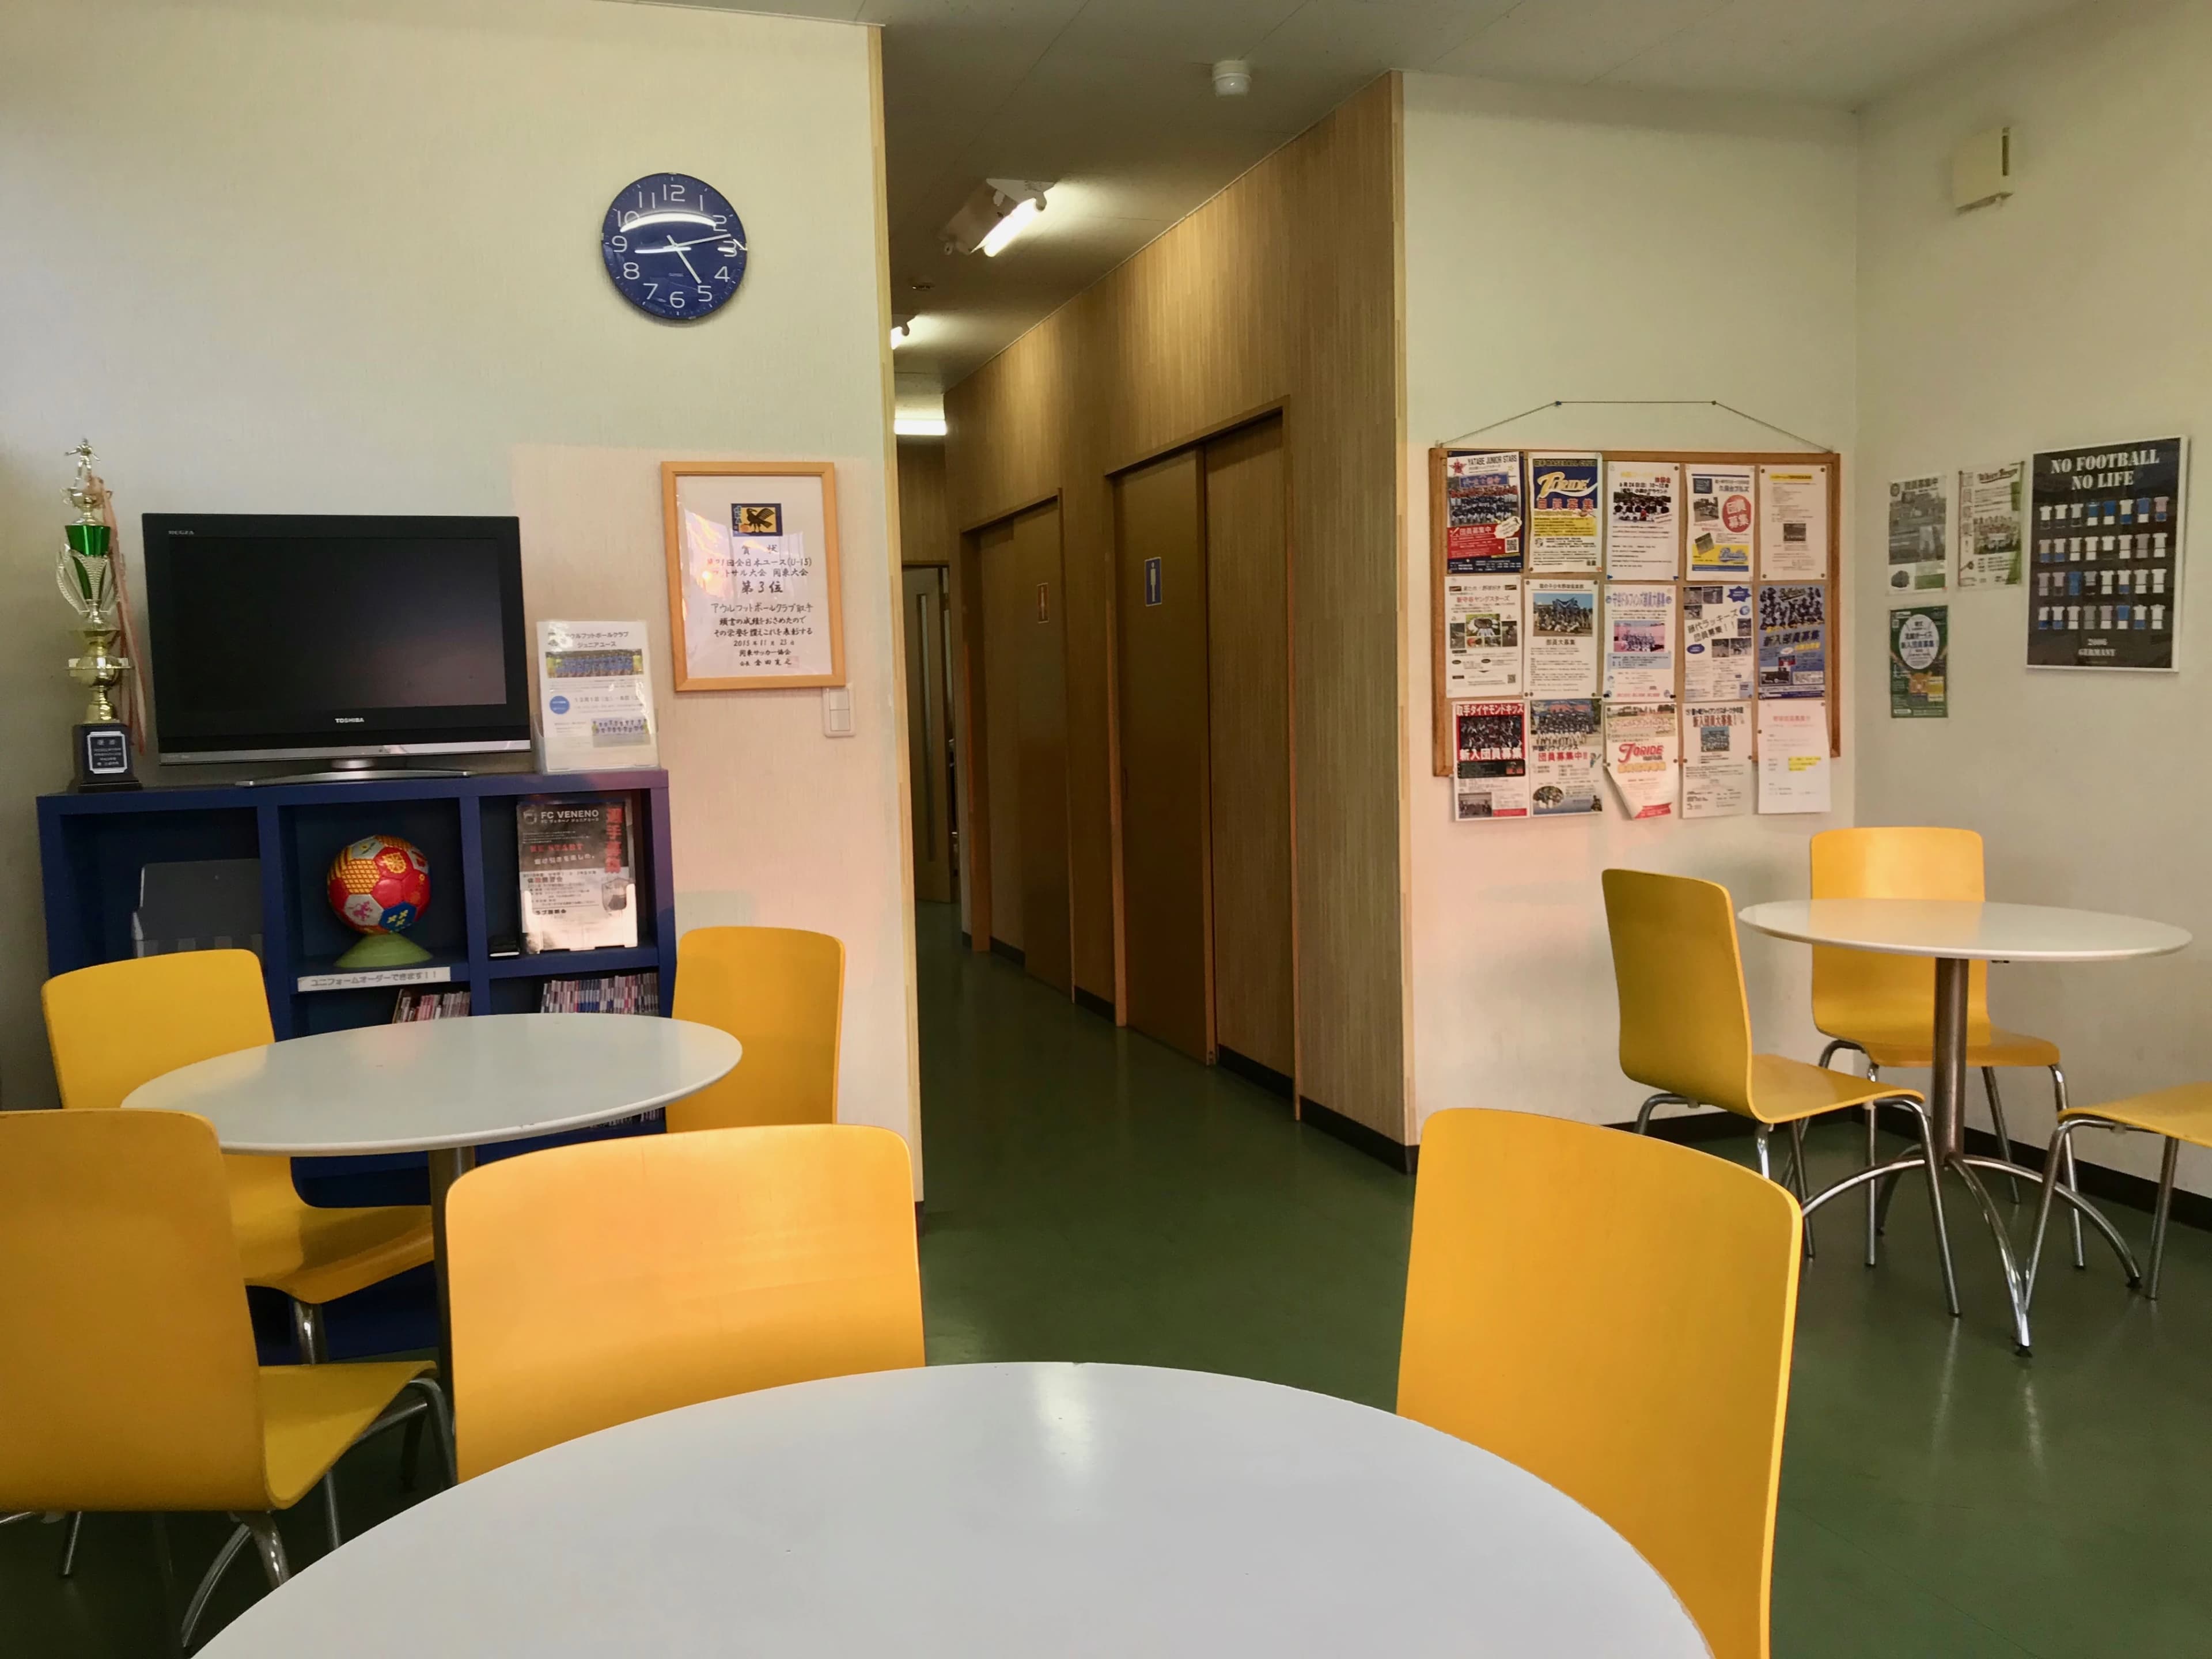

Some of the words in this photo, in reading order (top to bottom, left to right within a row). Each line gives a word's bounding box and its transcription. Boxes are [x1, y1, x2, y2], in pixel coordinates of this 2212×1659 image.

[638, 191, 656, 209] 11
[663, 184, 685, 202] 12
[699, 194, 704, 212] 1
[712, 214, 728, 232] 2
[611, 235, 628, 253] 9
[722, 240, 738, 257] 3
[623, 262, 641, 280] 8
[714, 266, 731, 283] 4
[642, 282, 659, 300] 7
[669, 291, 686, 309] 6
[697, 285, 713, 302] 5
[2050, 458, 2073, 474] NO
[2076, 449, 2160, 472] FOOTBALL
[2071, 474, 2094, 490] NO
[2097, 470, 2134, 488] LIFE
[540, 811, 554, 819] FC
[556, 809, 599, 819] VENENO
